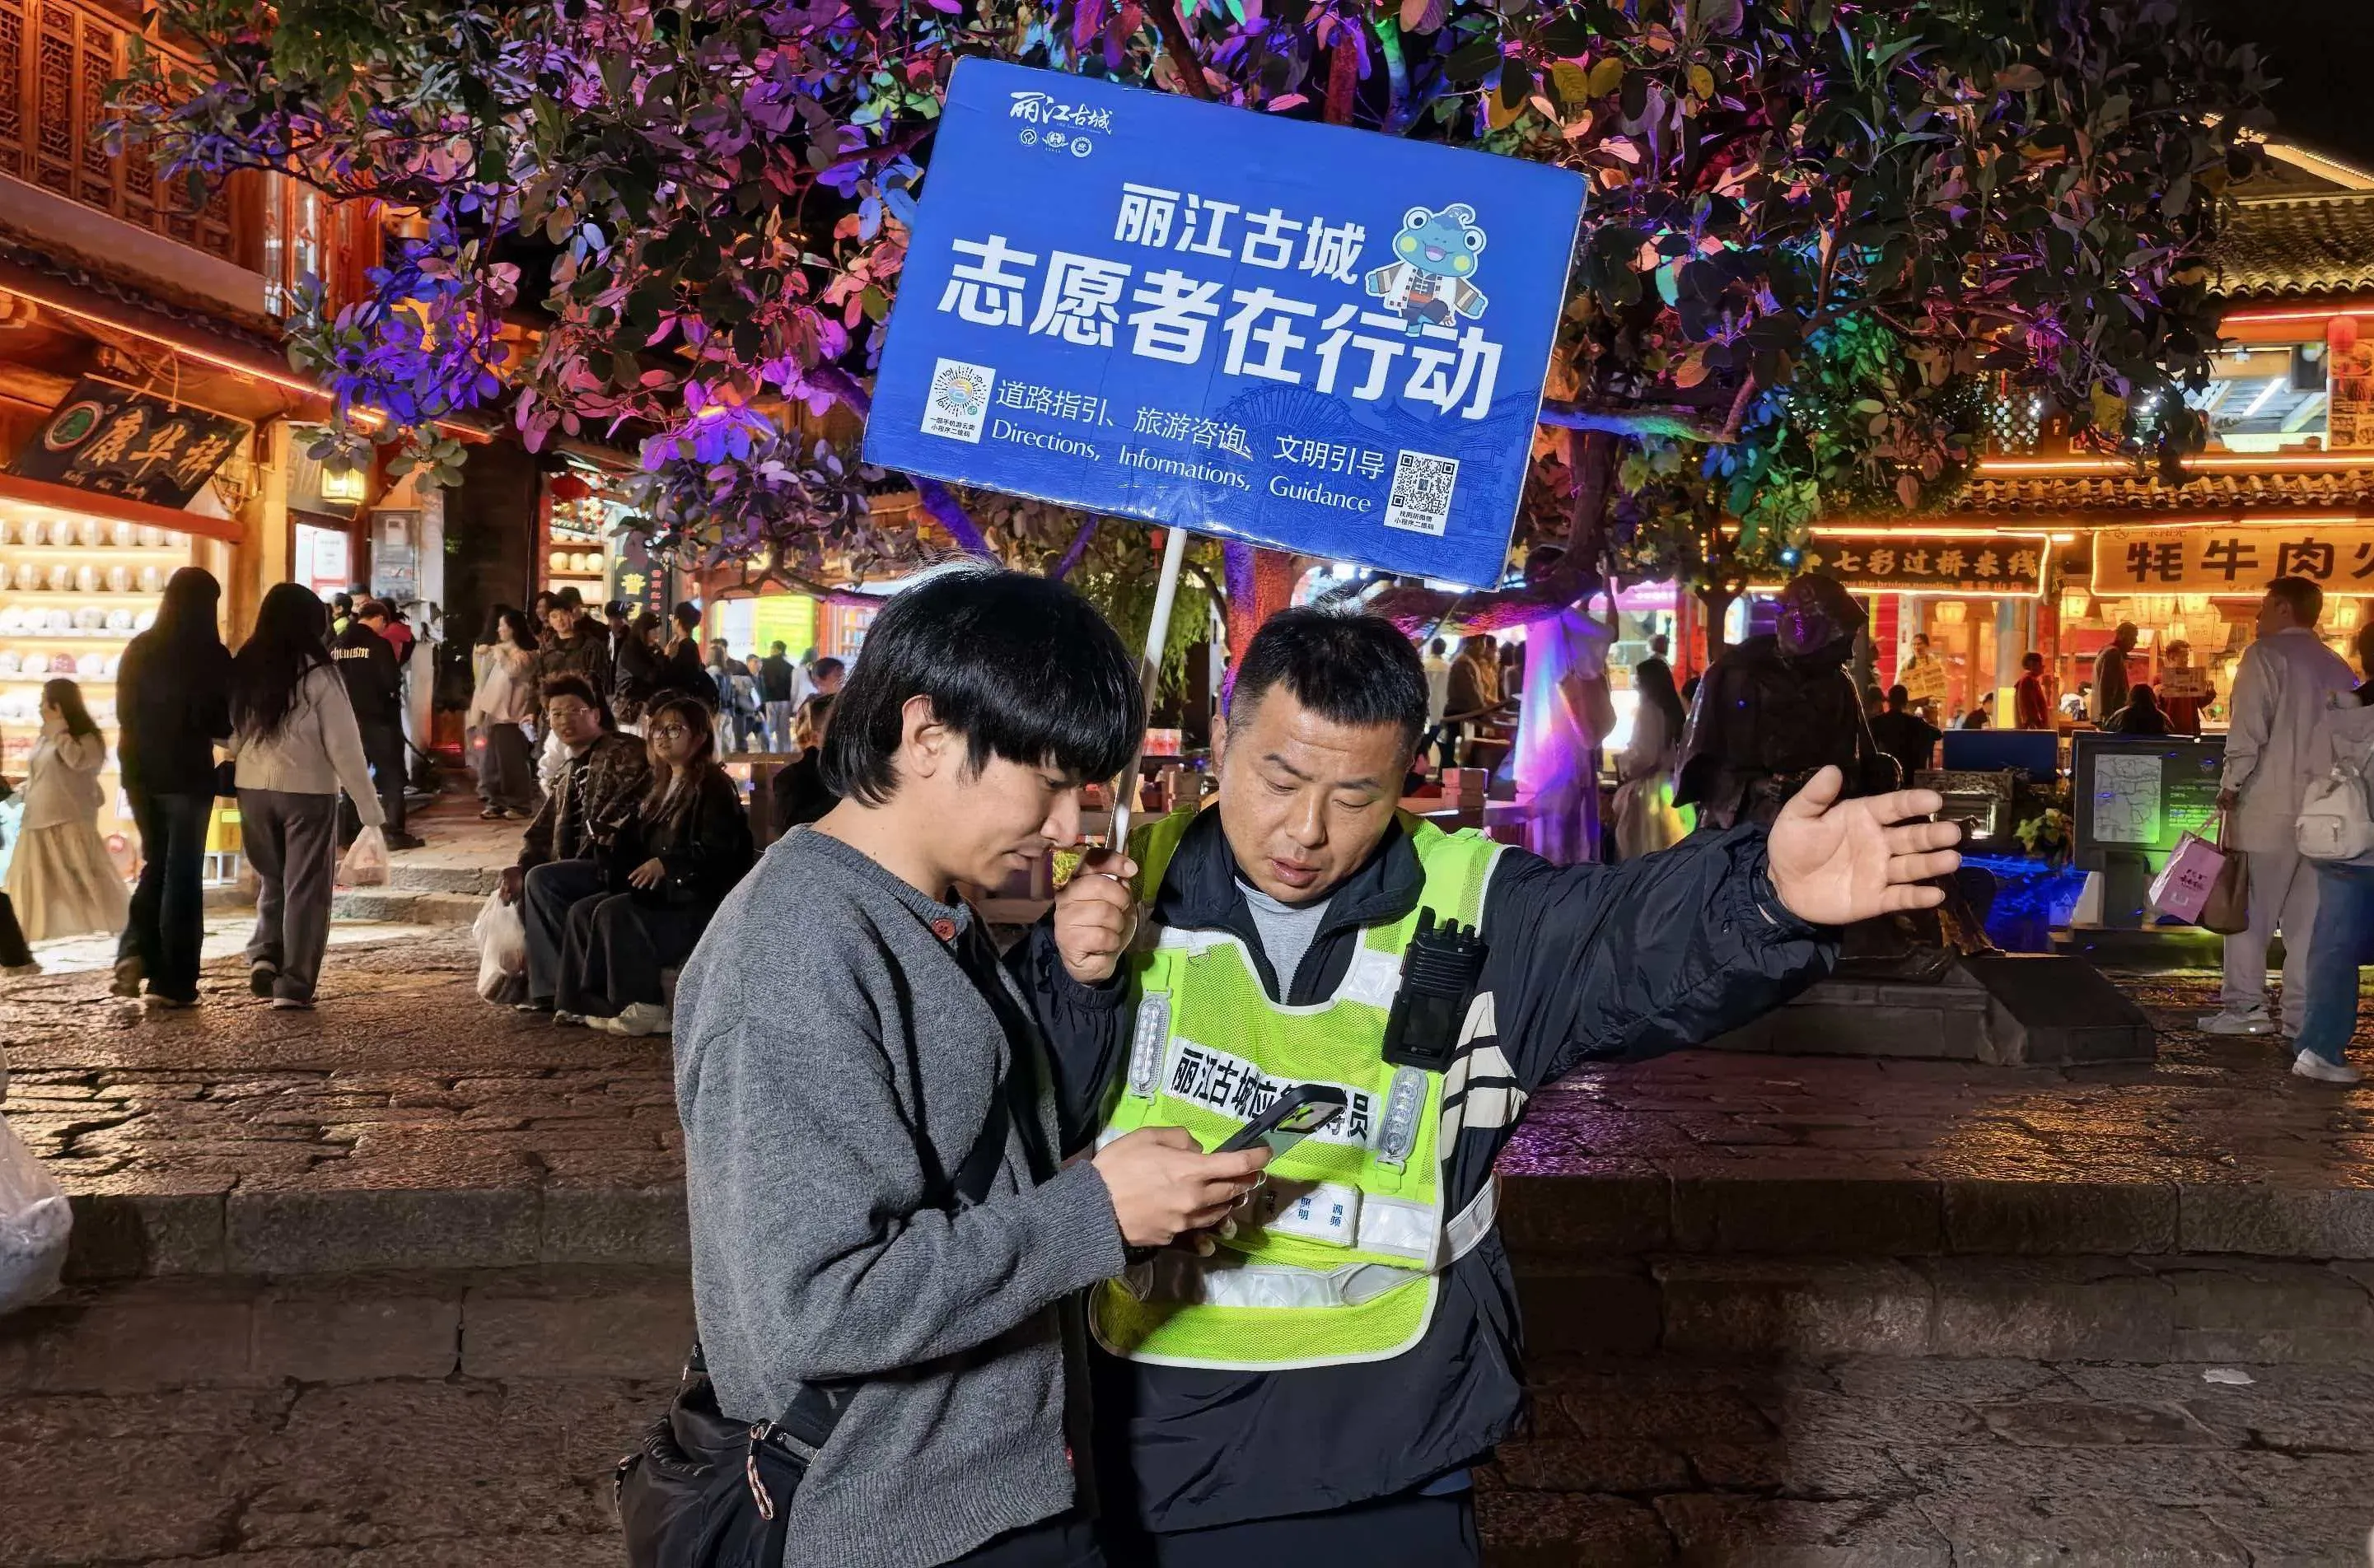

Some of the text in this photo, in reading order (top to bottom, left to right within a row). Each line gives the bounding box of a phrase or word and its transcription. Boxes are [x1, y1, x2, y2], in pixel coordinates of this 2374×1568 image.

[1010, 91, 1113, 135] 丽江古城
[1114, 182, 1366, 285] 丽江古城
[937, 234, 1503, 420] 志愿者在行动
[992, 418, 1372, 512] Directions, Informations, Guidance
[1273, 435, 1385, 479] 文明引导
[1832, 549, 2037, 578] 七彩过桥米线
